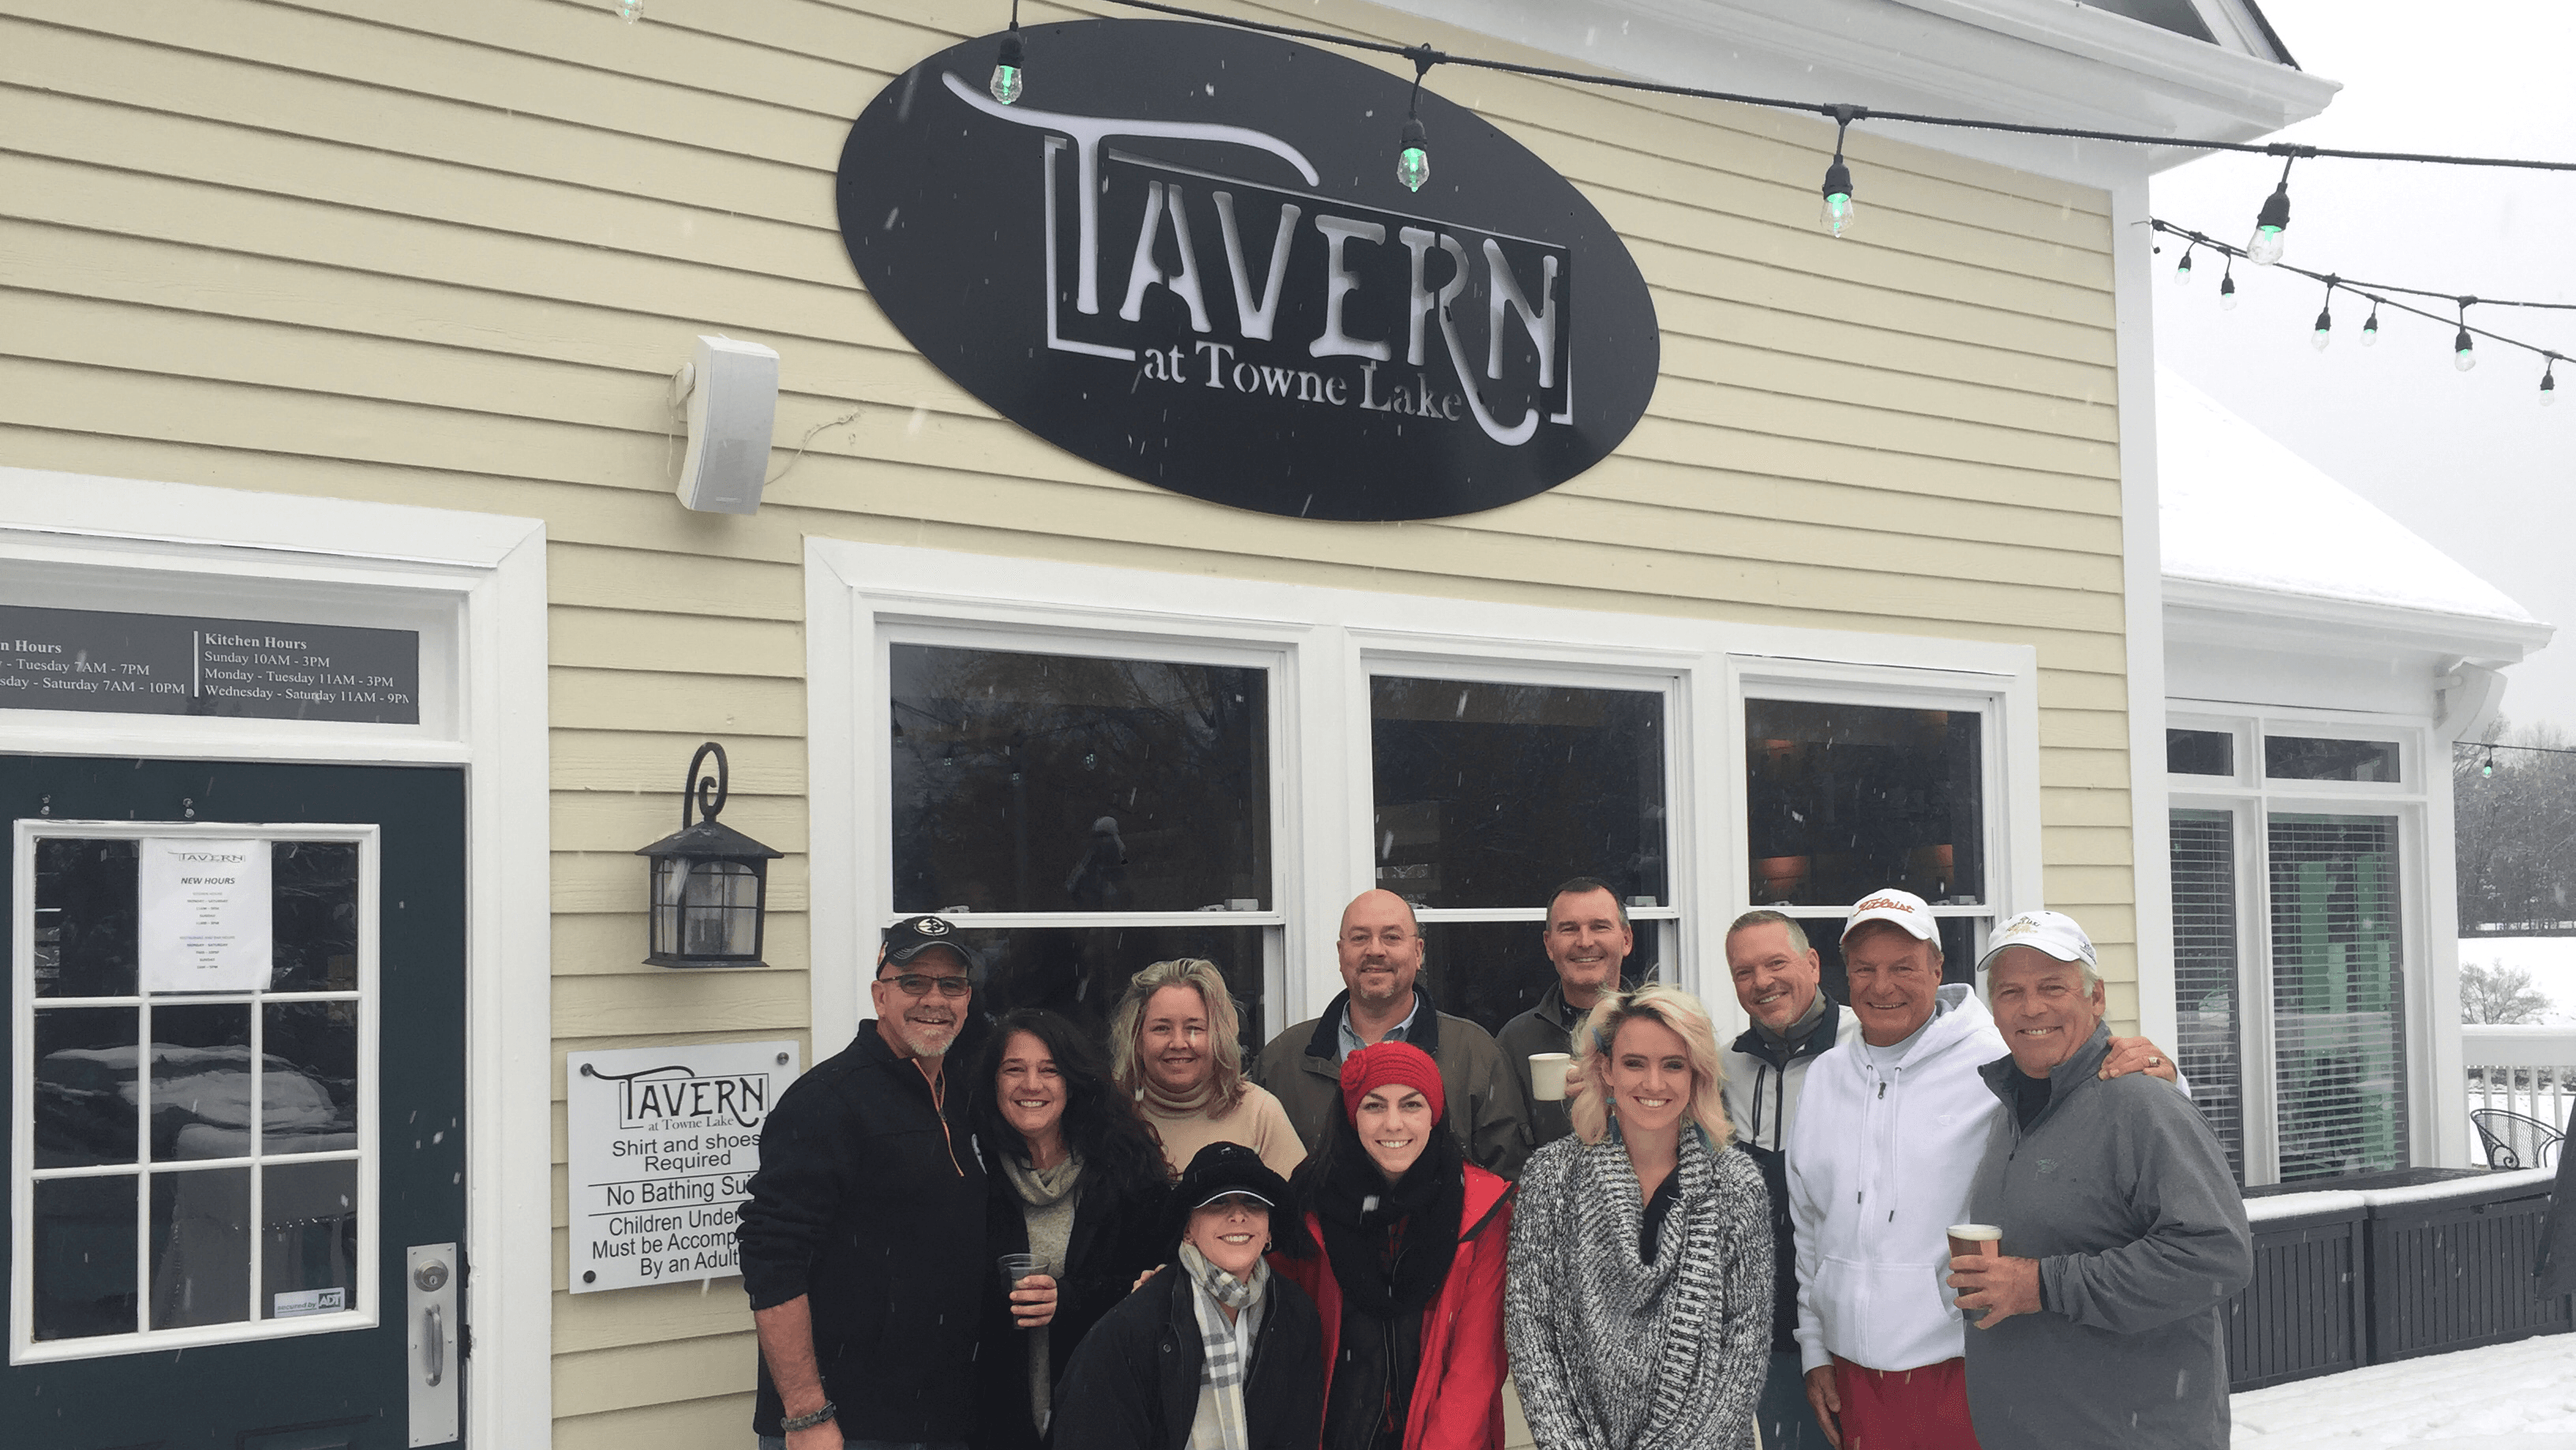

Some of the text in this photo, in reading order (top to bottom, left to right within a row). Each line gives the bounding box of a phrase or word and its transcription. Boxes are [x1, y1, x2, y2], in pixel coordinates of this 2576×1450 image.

[942, 71, 1559, 447] TAVERN
[1144, 339, 1462, 422] at Towne Lake
[15, 639, 62, 654] Hours
[204, 632, 308, 650] Kitchen Hours
[16, 658, 69, 674] Tuesday
[74, 661, 107, 674] 7AM
[120, 664, 150, 676] 7PM
[204, 650, 249, 666] Sunday
[254, 654, 290, 665] 10AM
[302, 656, 330, 668] 3PM
[43, 677, 99, 693] Saturday
[103, 680, 135, 692] 7AM
[149, 681, 185, 695] 10PM
[204, 668, 254, 684] Monday
[266, 670, 315, 686] Tuesday
[320, 673, 355, 685] 11AM
[366, 676, 394, 688] 3PM
[204, 684, 274, 701] Wednesday
[285, 688, 337, 703] Saturday
[341, 691, 376, 703] 11AM
[167, 852, 243, 863] TAVERN
[592, 1065, 764, 1128] TAVERN
[648, 1115, 735, 1132] at Towne Lake
[612, 1133, 762, 1157] Shirt and shoes
[645, 1149, 732, 1174] Required
[607, 1185, 635, 1207] No
[642, 1179, 715, 1203] Bathing
[609, 1214, 683, 1236] Children
[593, 1231, 740, 1260] Must be Accomp
[640, 1248, 739, 1280] By an Adult
[277, 1302, 307, 1310] secured
[319, 1295, 341, 1306] ADT
